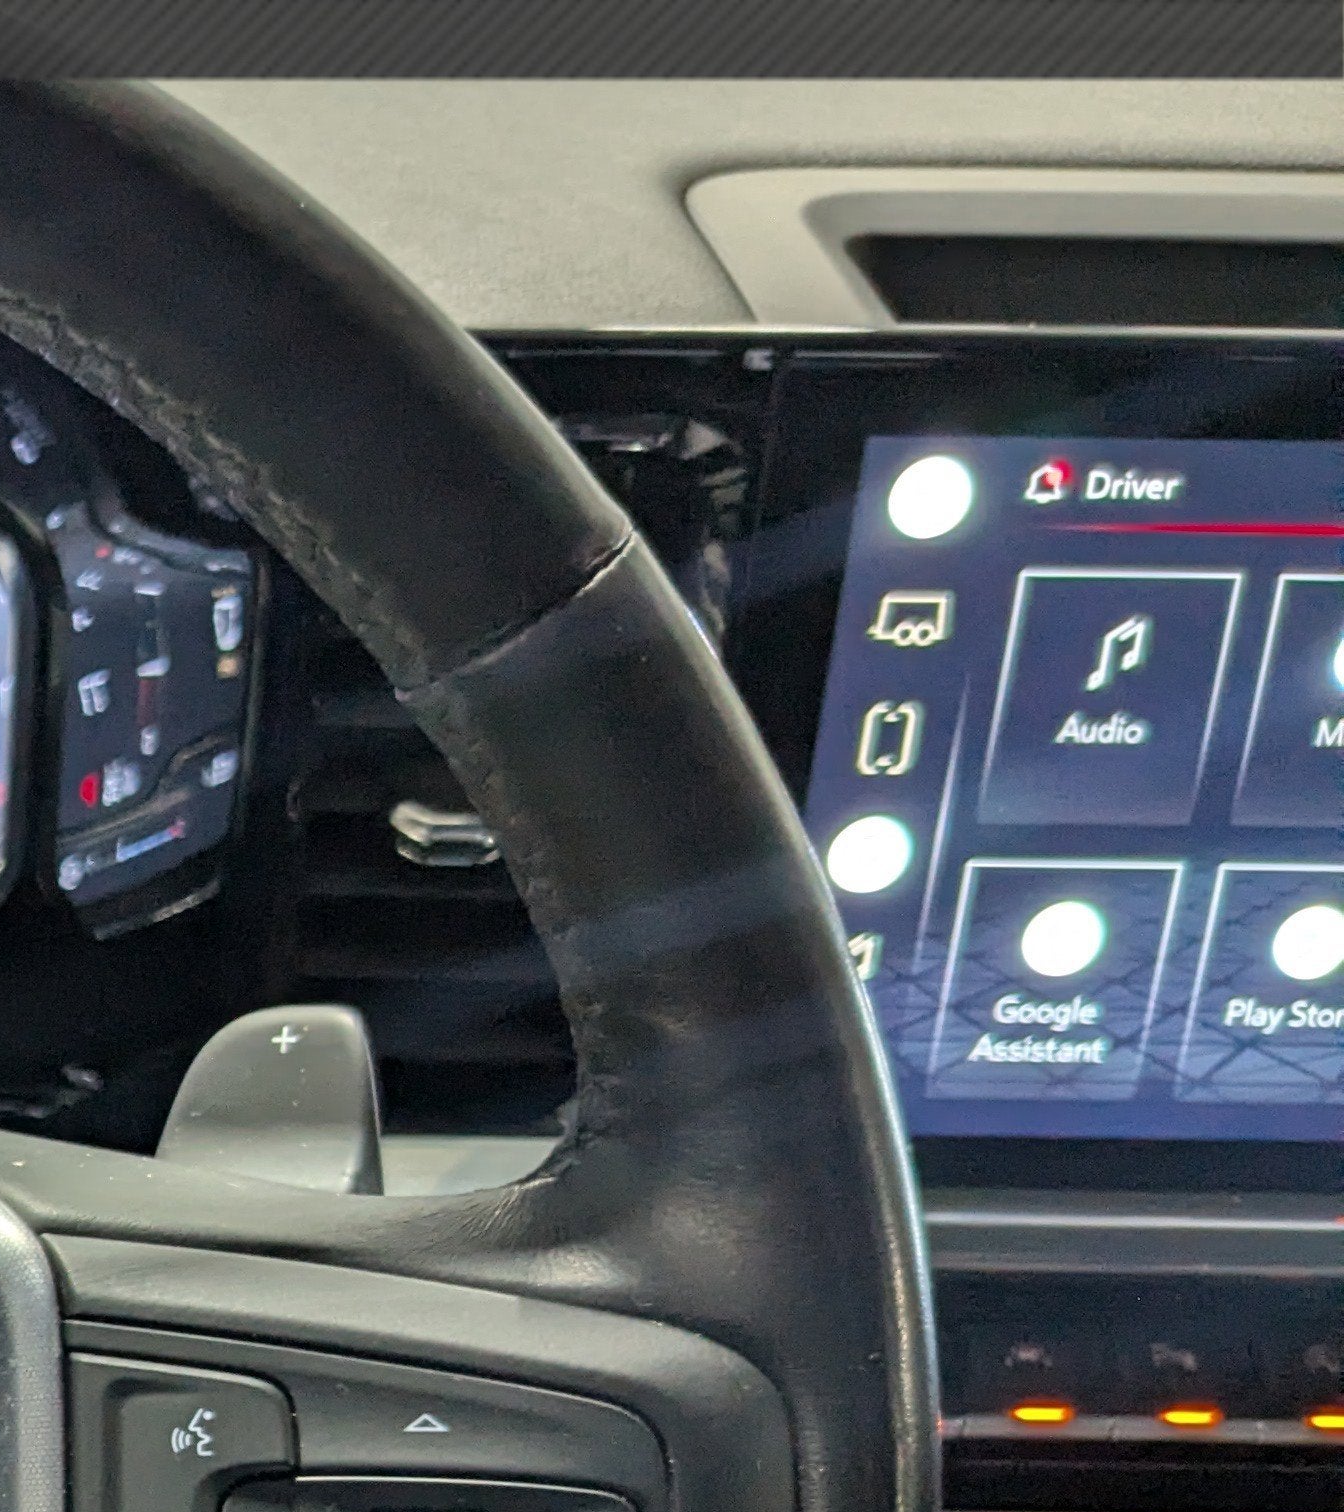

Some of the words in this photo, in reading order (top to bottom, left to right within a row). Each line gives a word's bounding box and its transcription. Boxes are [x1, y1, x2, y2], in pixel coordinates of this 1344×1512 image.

[1085, 468, 1180, 501] Driver
[1055, 710, 1147, 746] Audio
[993, 994, 1100, 1026] Google
[1224, 998, 1286, 1035] Play
[969, 1034, 1105, 1063] Assistant
